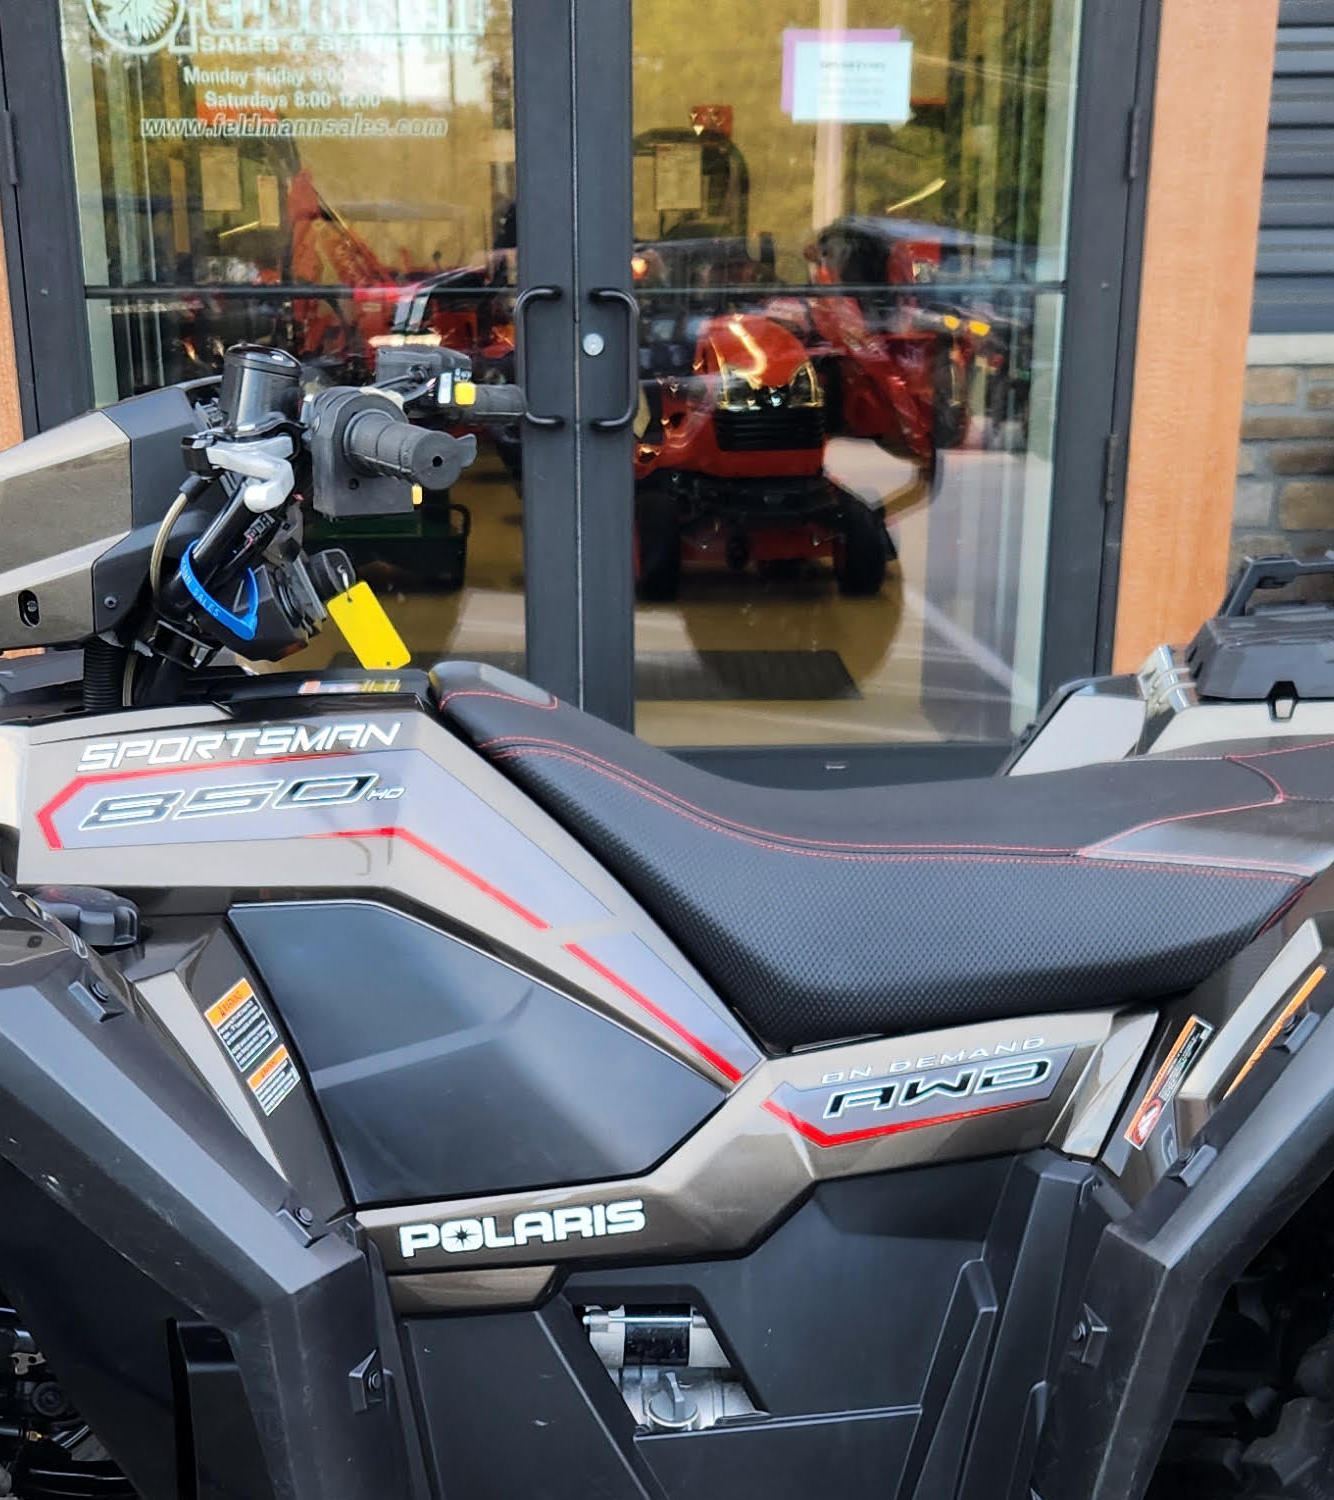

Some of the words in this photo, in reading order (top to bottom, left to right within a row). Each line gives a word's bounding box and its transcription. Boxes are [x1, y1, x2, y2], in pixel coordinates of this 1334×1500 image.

[199, 36, 280, 53] SALES
[289, 36, 307, 53] &
[204, 91, 288, 110] Saturdays
[141, 114, 448, 138] www.feldmannsales.com
[192, 587, 220, 617] SALES
[76, 721, 402, 772] SPORTSMAN
[78, 773, 379, 831] 850
[367, 786, 405, 801] HD
[821, 1066, 873, 1085] ON
[889, 1037, 1045, 1073] DEMAND
[822, 1058, 1053, 1119] AWD
[398, 1199, 646, 1258] POLARIS
